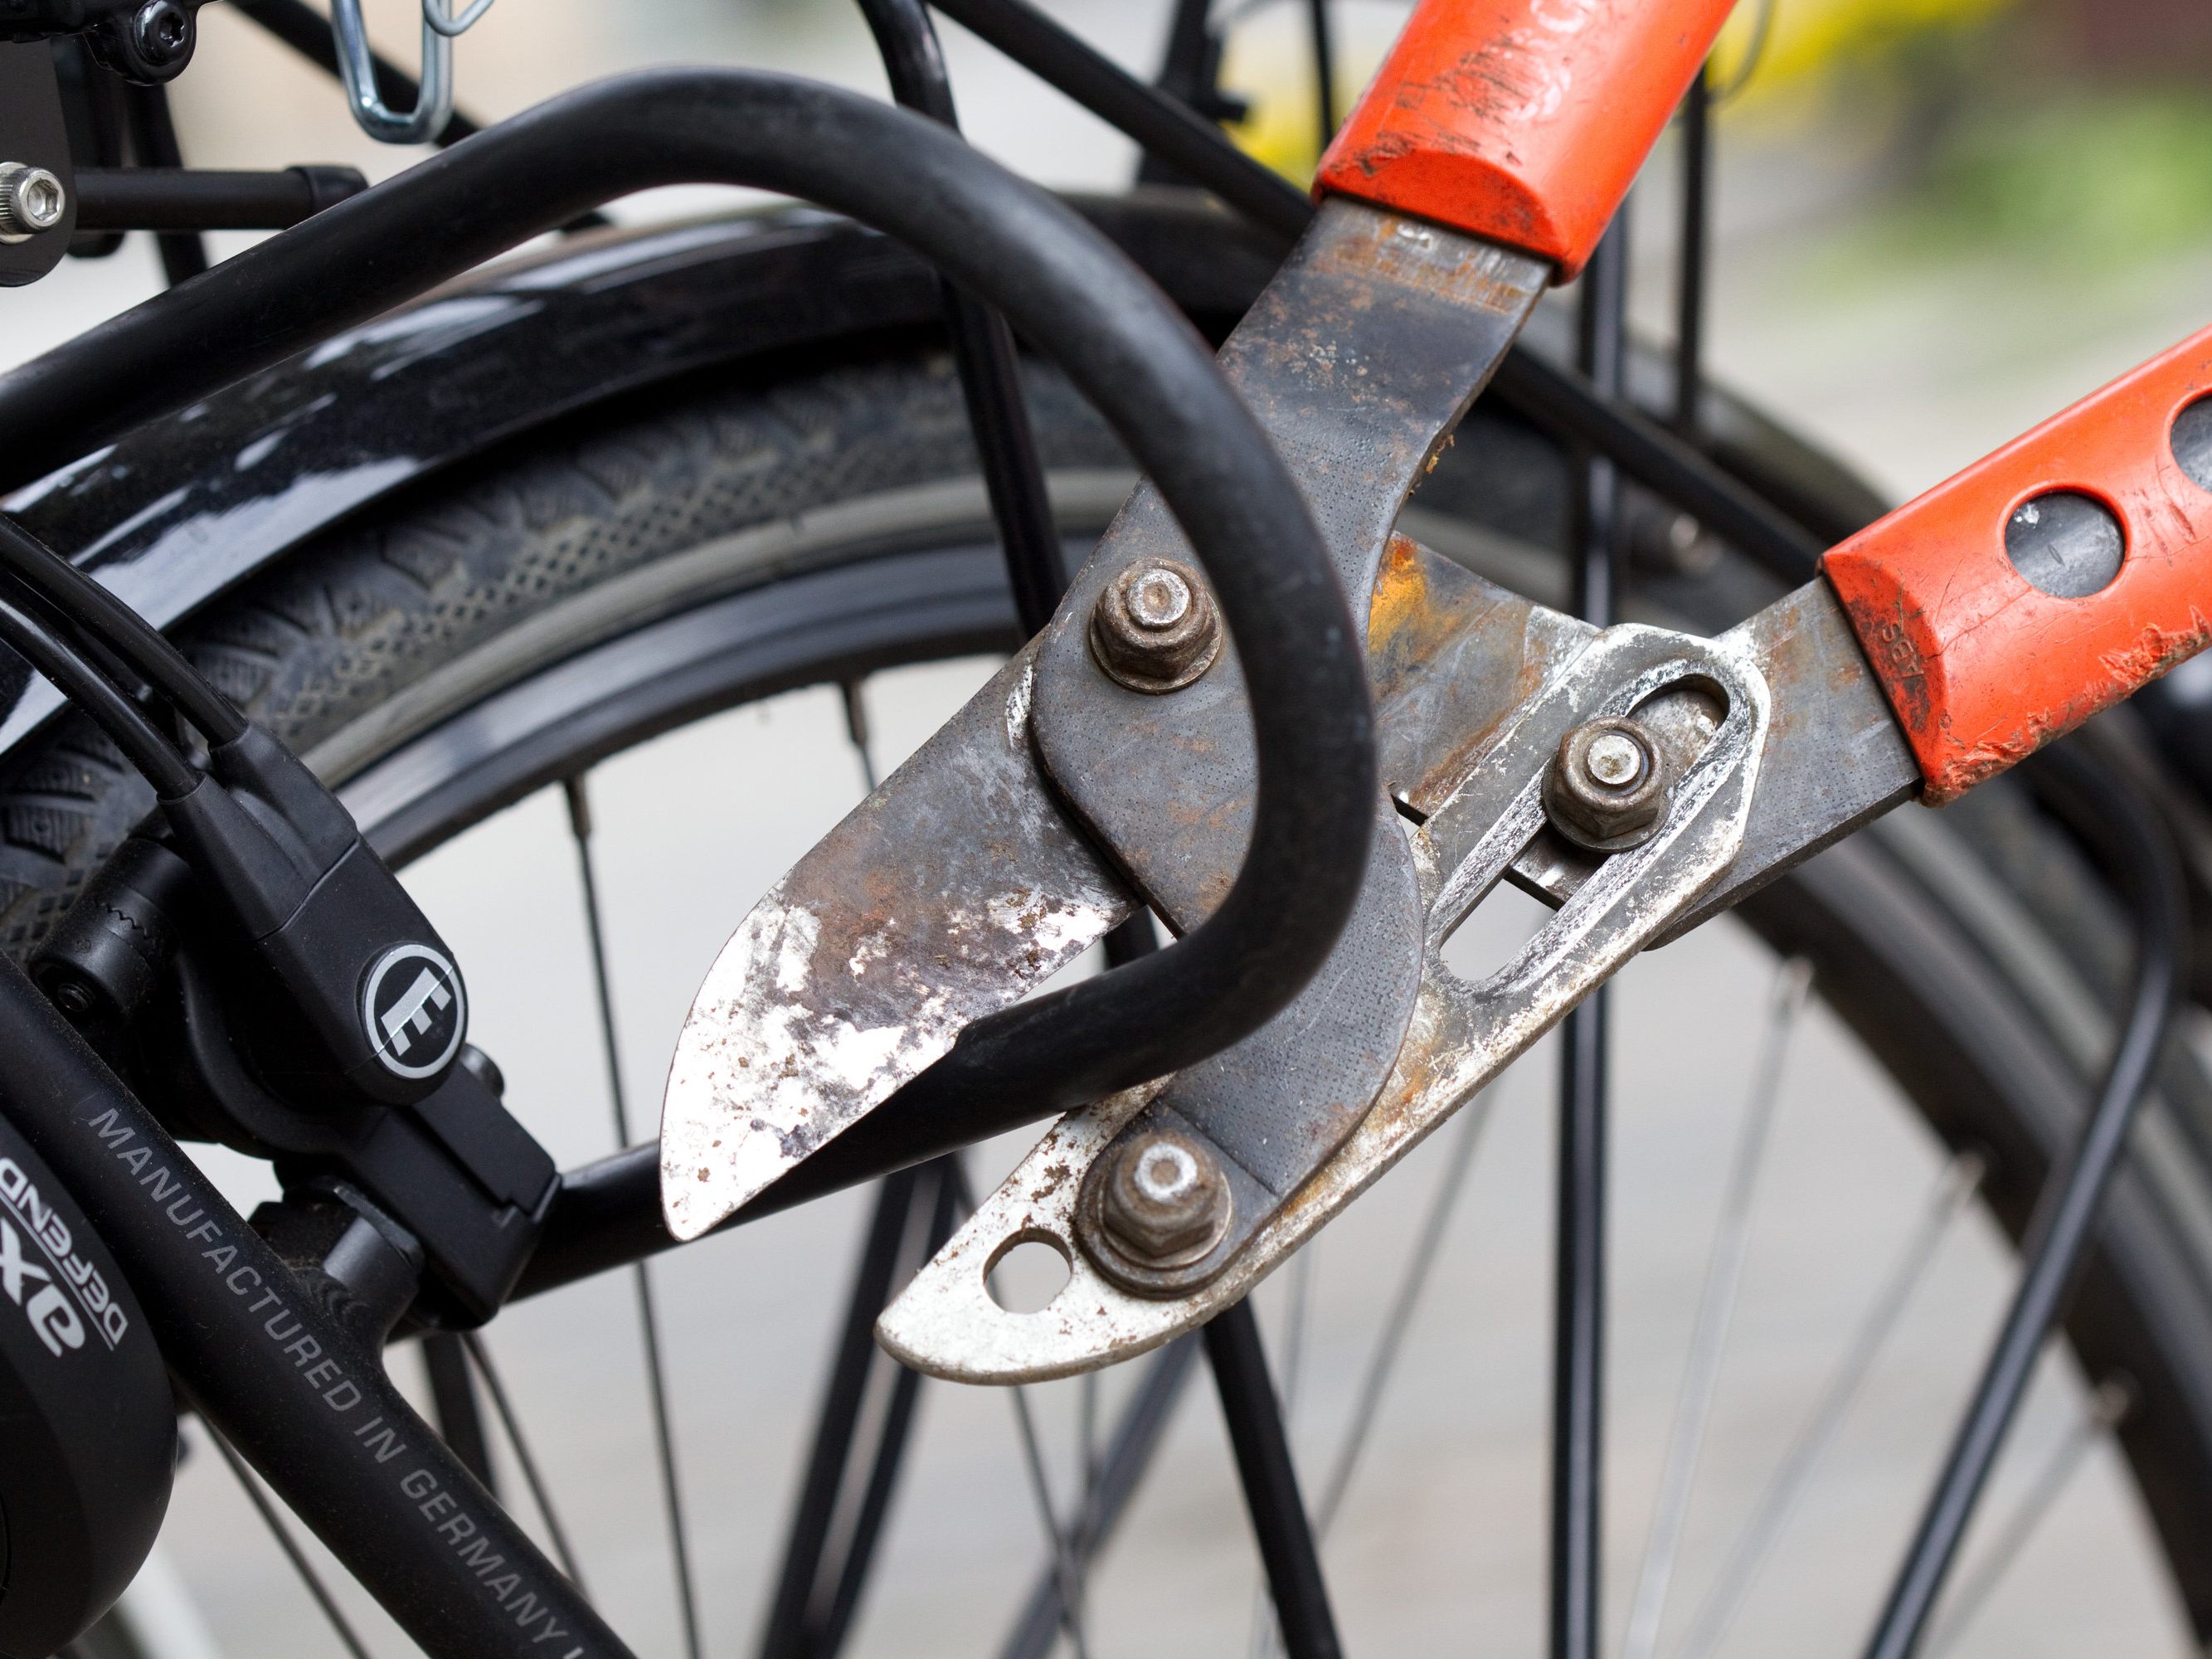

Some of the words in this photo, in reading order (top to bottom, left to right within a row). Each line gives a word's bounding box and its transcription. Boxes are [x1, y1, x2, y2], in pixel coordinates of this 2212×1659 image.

[1882, 620, 1924, 678] ABS
[0, 1157, 129, 1345] DEFEND
[89, 1107, 362, 1411] MANUFACTURED
[353, 1416, 406, 1463] IN
[400, 1469, 568, 1643] GERMANY
